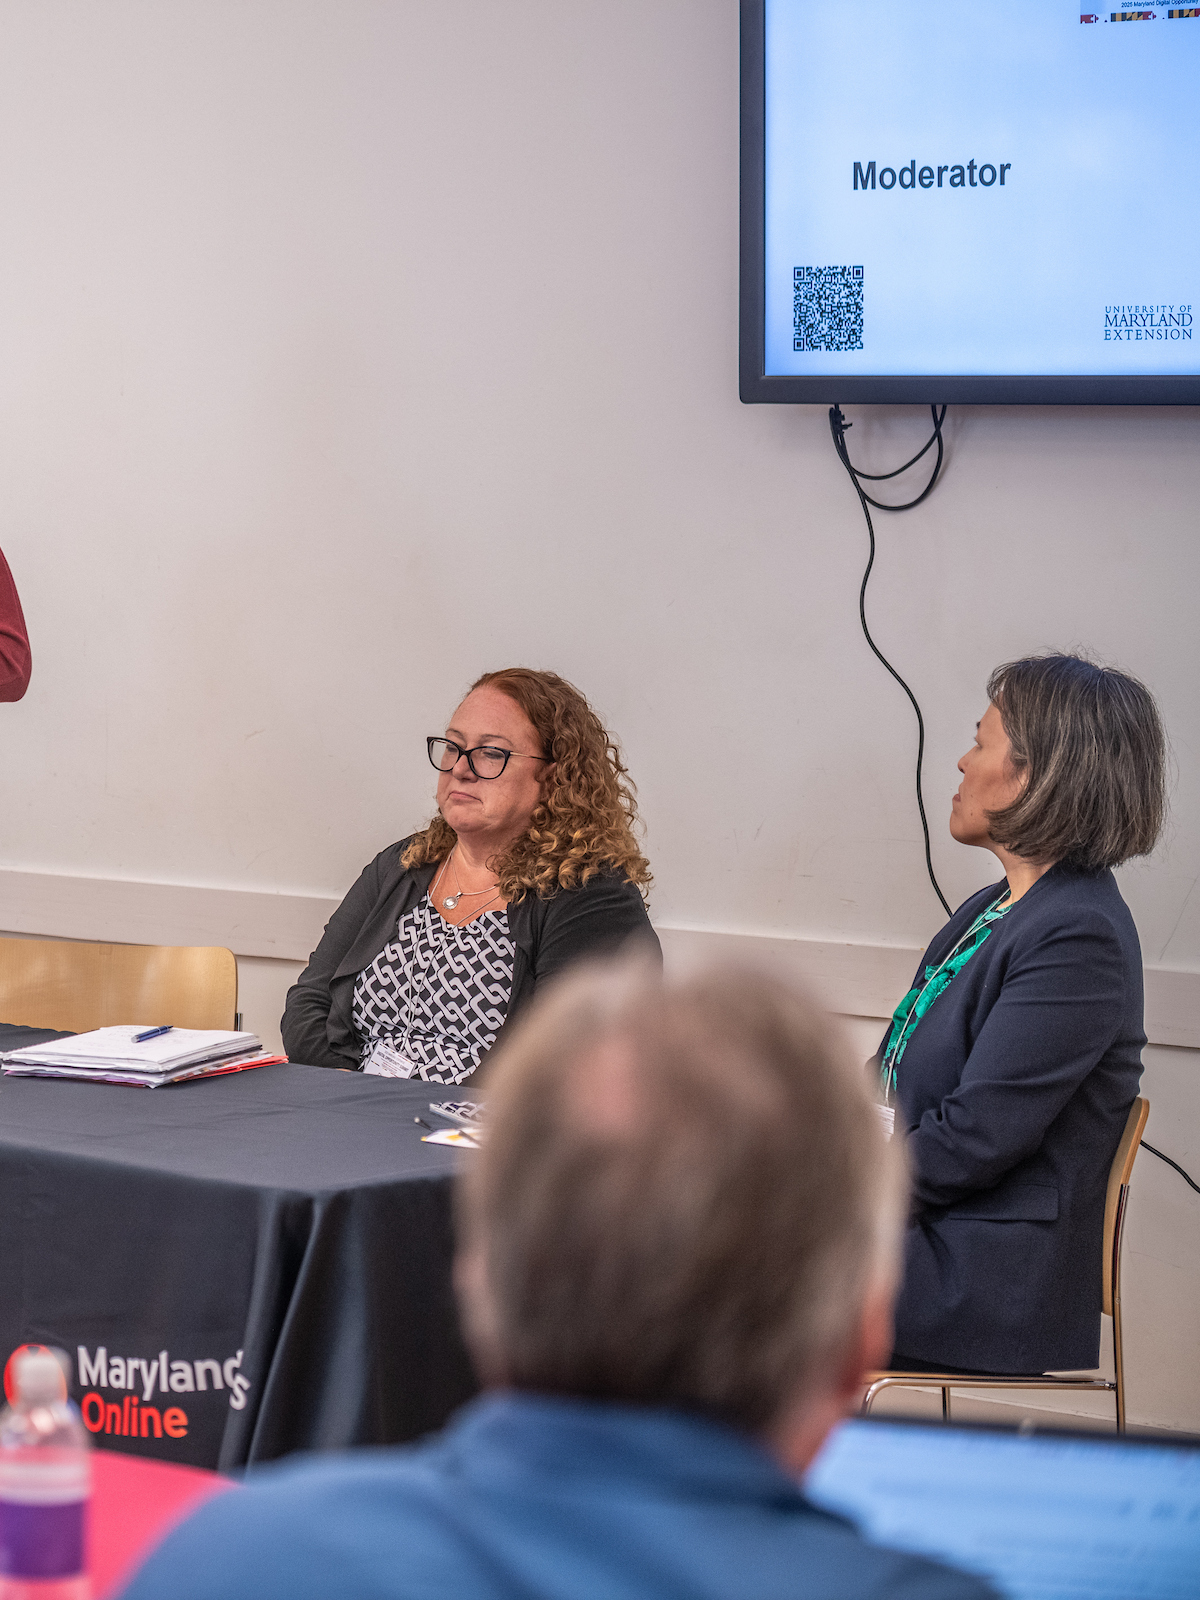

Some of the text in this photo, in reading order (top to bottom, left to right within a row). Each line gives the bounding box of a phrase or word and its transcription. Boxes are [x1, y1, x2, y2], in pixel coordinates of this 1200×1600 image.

[853, 158, 1012, 190] Moderator
[1104, 304, 1192, 313] UNIVERSITY OF
[1104, 313, 1193, 327] MARYLAND
[1103, 328, 1193, 340] EXTENSION
[81, 1391, 189, 1439] Online
